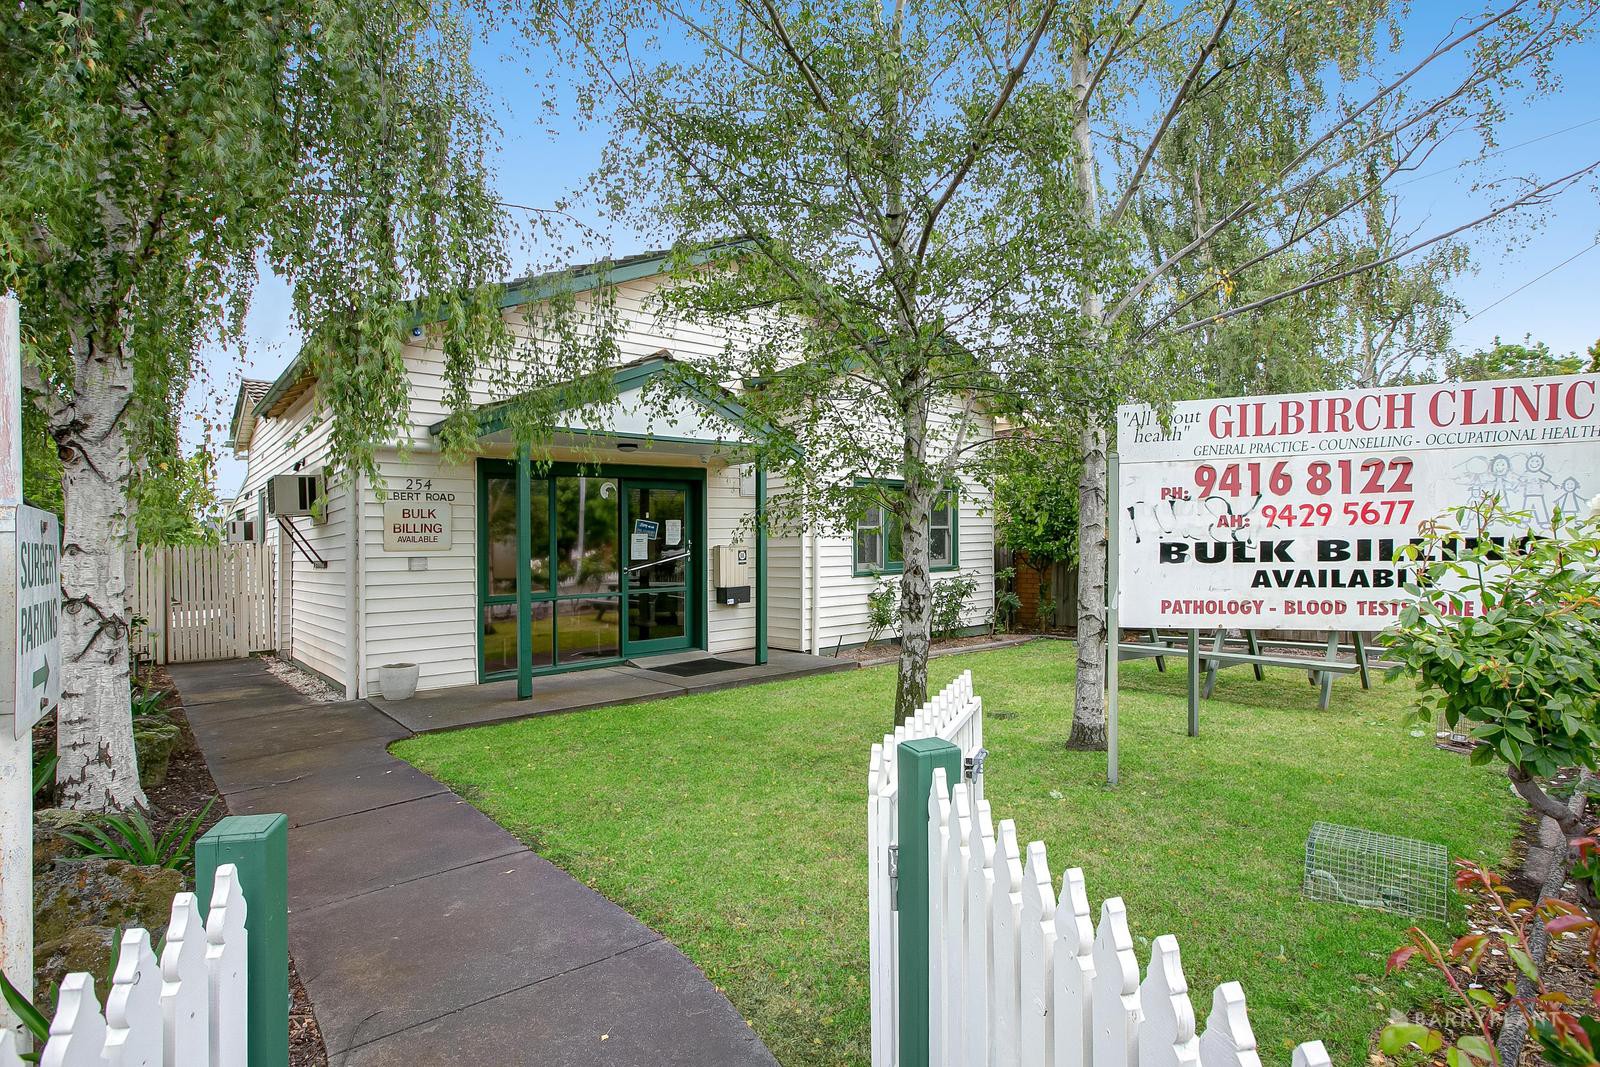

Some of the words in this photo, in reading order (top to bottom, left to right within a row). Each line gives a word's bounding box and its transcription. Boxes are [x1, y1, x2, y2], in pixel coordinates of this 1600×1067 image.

[1208, 393, 1416, 439] GILBIRCH
[1428, 380, 1595, 428] CLINIC
[1193, 443, 1247, 457] GENERAL
[1249, 440, 1309, 455] PRACTICE
[1318, 434, 1413, 451] COUNSELLING
[1425, 428, 1537, 446] OCCUPATIONAL
[1541, 425, 1600, 440] HEALTH
[405, 478, 432, 490] 254
[1161, 487, 1190, 500] PH:
[1194, 461, 1293, 498] 9416
[1306, 456, 1414, 496] 8122
[425, 492, 456, 502] ROAD
[402, 508, 437, 519] BULK
[1216, 514, 1250, 528] AH:
[1261, 503, 1333, 528] 9429
[1343, 499, 1415, 526] 5677
[393, 523, 443, 534] BILLING
[397, 535, 438, 543] AVAILABLE
[1159, 539, 1295, 564] BULK
[20, 541, 58, 590] SURGERY
[1161, 600, 1264, 615] PATHOLOGY
[1284, 600, 1348, 615] BLOOD
[1357, 600, 1409, 616] TEST
[1420, 601, 1474, 617] ONE
[20, 598, 58, 655] PARKING
